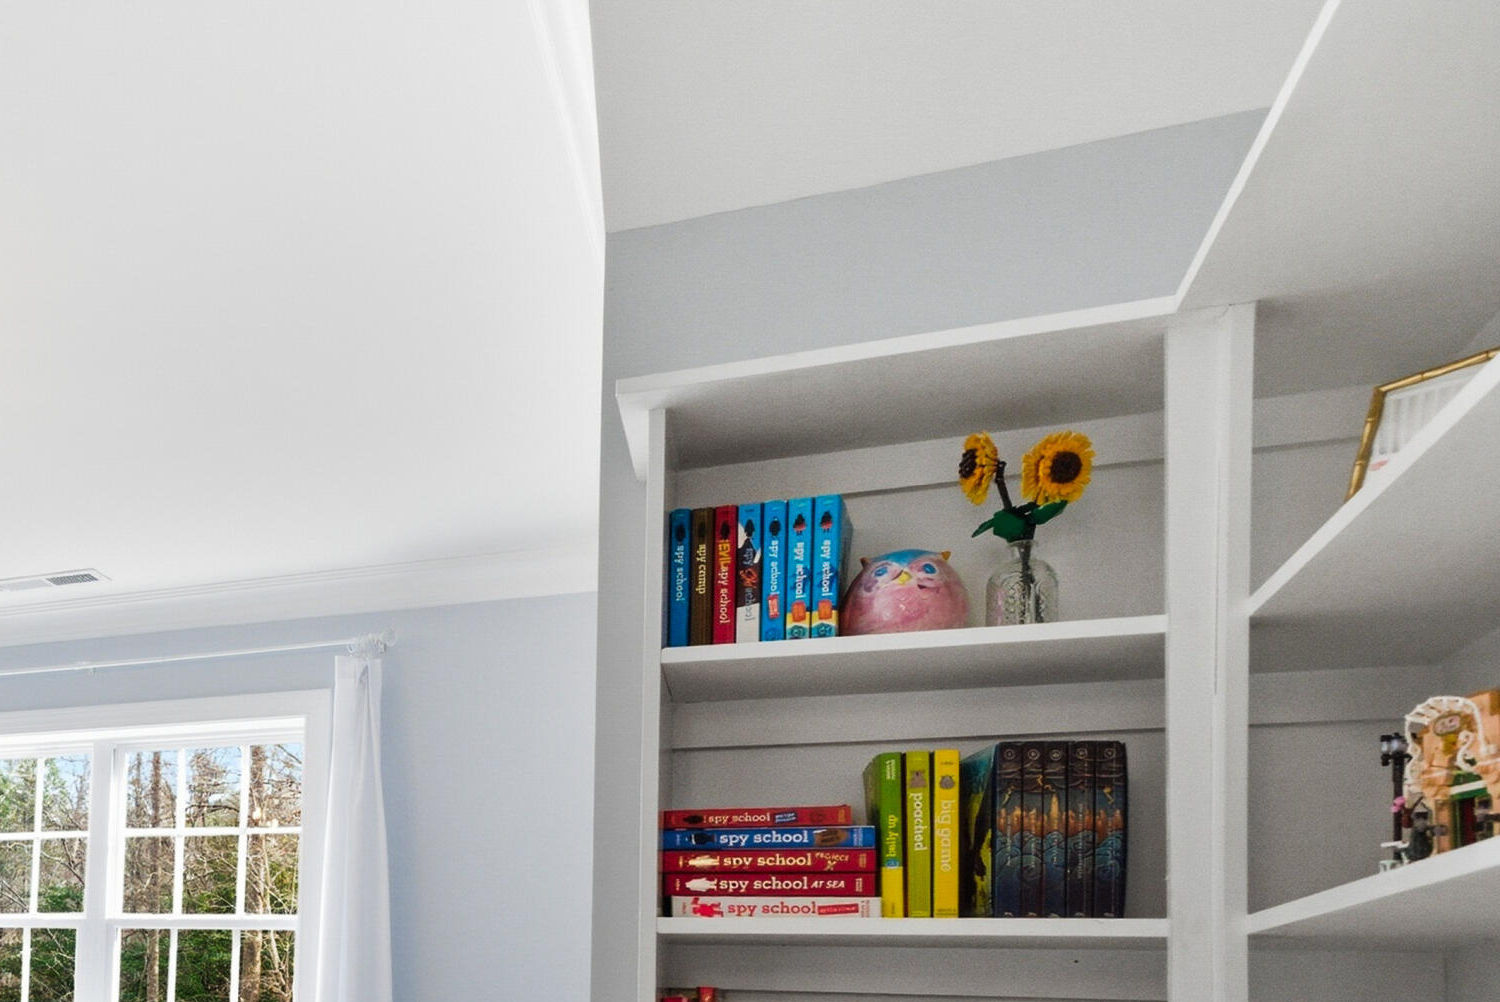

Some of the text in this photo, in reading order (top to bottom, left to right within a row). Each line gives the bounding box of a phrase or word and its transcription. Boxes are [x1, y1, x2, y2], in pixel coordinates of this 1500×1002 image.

[768, 540, 779, 558] spy
[675, 567, 686, 601] school
[695, 544, 707, 594] spy camp
[769, 562, 780, 596] school
[794, 541, 806, 599] spy school
[821, 540, 833, 597] spy school
[719, 588, 730, 624] school
[708, 813, 730, 824] spy
[732, 812, 770, 823] school
[910, 792, 928, 851] poached
[720, 831, 808, 846] spy school
[935, 800, 956, 872] big game
[757, 853, 811, 866] school
[719, 879, 749, 892] spy
[753, 877, 808, 890] school
[810, 880, 825, 889] AT
[826, 880, 846, 889] SEA
[728, 904, 758, 916] spy
[761, 902, 817, 914] school
